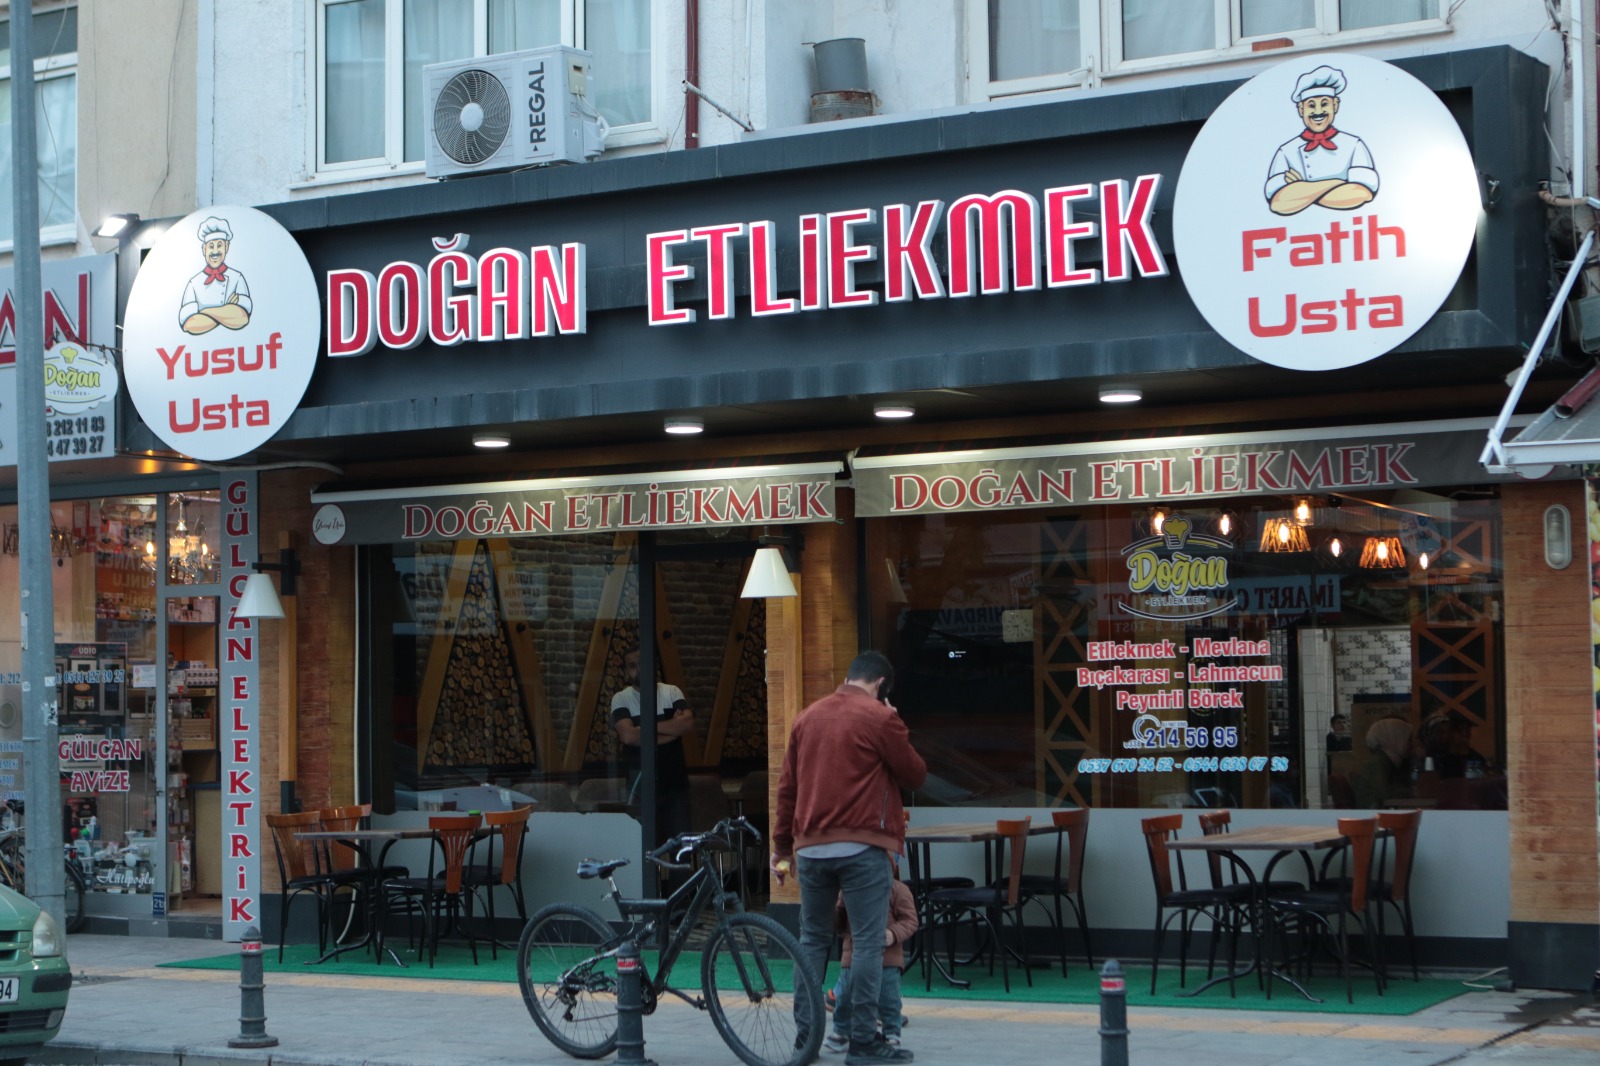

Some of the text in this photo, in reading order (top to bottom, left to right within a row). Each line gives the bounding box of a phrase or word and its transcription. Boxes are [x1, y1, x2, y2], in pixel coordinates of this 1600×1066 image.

[528, 61, 547, 144] REGAL
[1242, 214, 1407, 272] Fatih
[327, 173, 1170, 357] DOĞAN ETLİEKMEK
[1248, 288, 1404, 338] Usta
[156, 332, 283, 380] Yusuf
[45, 363, 101, 391] Doğan
[54, 419, 74, 435] 212
[75, 417, 88, 433] 11
[168, 394, 270, 434] Usta
[56, 439, 70, 455] 47
[72, 437, 87, 453] 39
[89, 436, 104, 453] 27
[890, 442, 1419, 512] DOĞAN ETLİEKMEK
[401, 481, 833, 539] DOĞAN ETLİEKMEK
[1127, 549, 1229, 596] Doğan
[1087, 639, 1176, 661] Etliekmek
[1193, 637, 1271, 658] Mevlana
[114, 669, 125, 682] 27
[1077, 666, 1170, 690] Bıçakarası
[1188, 663, 1283, 683] Lahmacun
[1116, 689, 1243, 713] Peynirli Börek
[58, 734, 141, 761] GÜLCAN
[1145, 728, 1180, 748] 214
[1185, 727, 1208, 748] 56
[1213, 727, 1238, 748] 95
[1183, 757, 1218, 772] 0544
[1248, 757, 1268, 772] 07
[70, 770, 130, 792] AVİZE
[227, 675, 255, 922] ELEKTRİK
